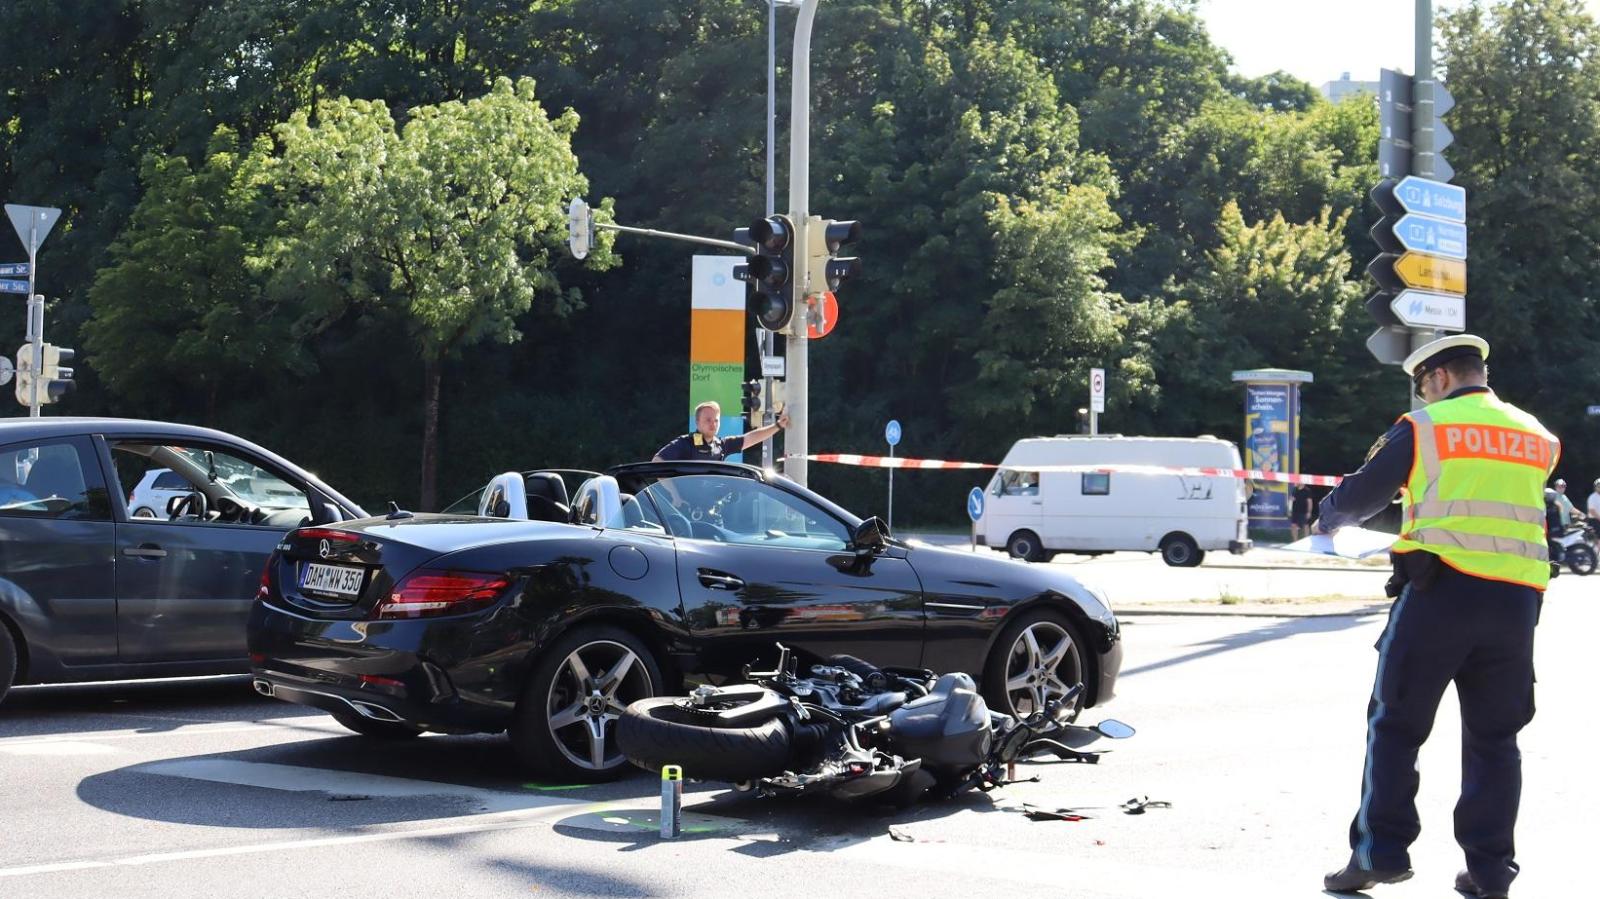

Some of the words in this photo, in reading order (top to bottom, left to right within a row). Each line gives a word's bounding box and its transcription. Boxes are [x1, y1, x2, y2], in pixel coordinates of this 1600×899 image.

[692, 363, 742, 374] Olympisches
[692, 373, 710, 381] Dorf
[1446, 427, 1546, 464] POLIZEI
[305, 566, 325, 587] DAH
[342, 570, 362, 592] 350
